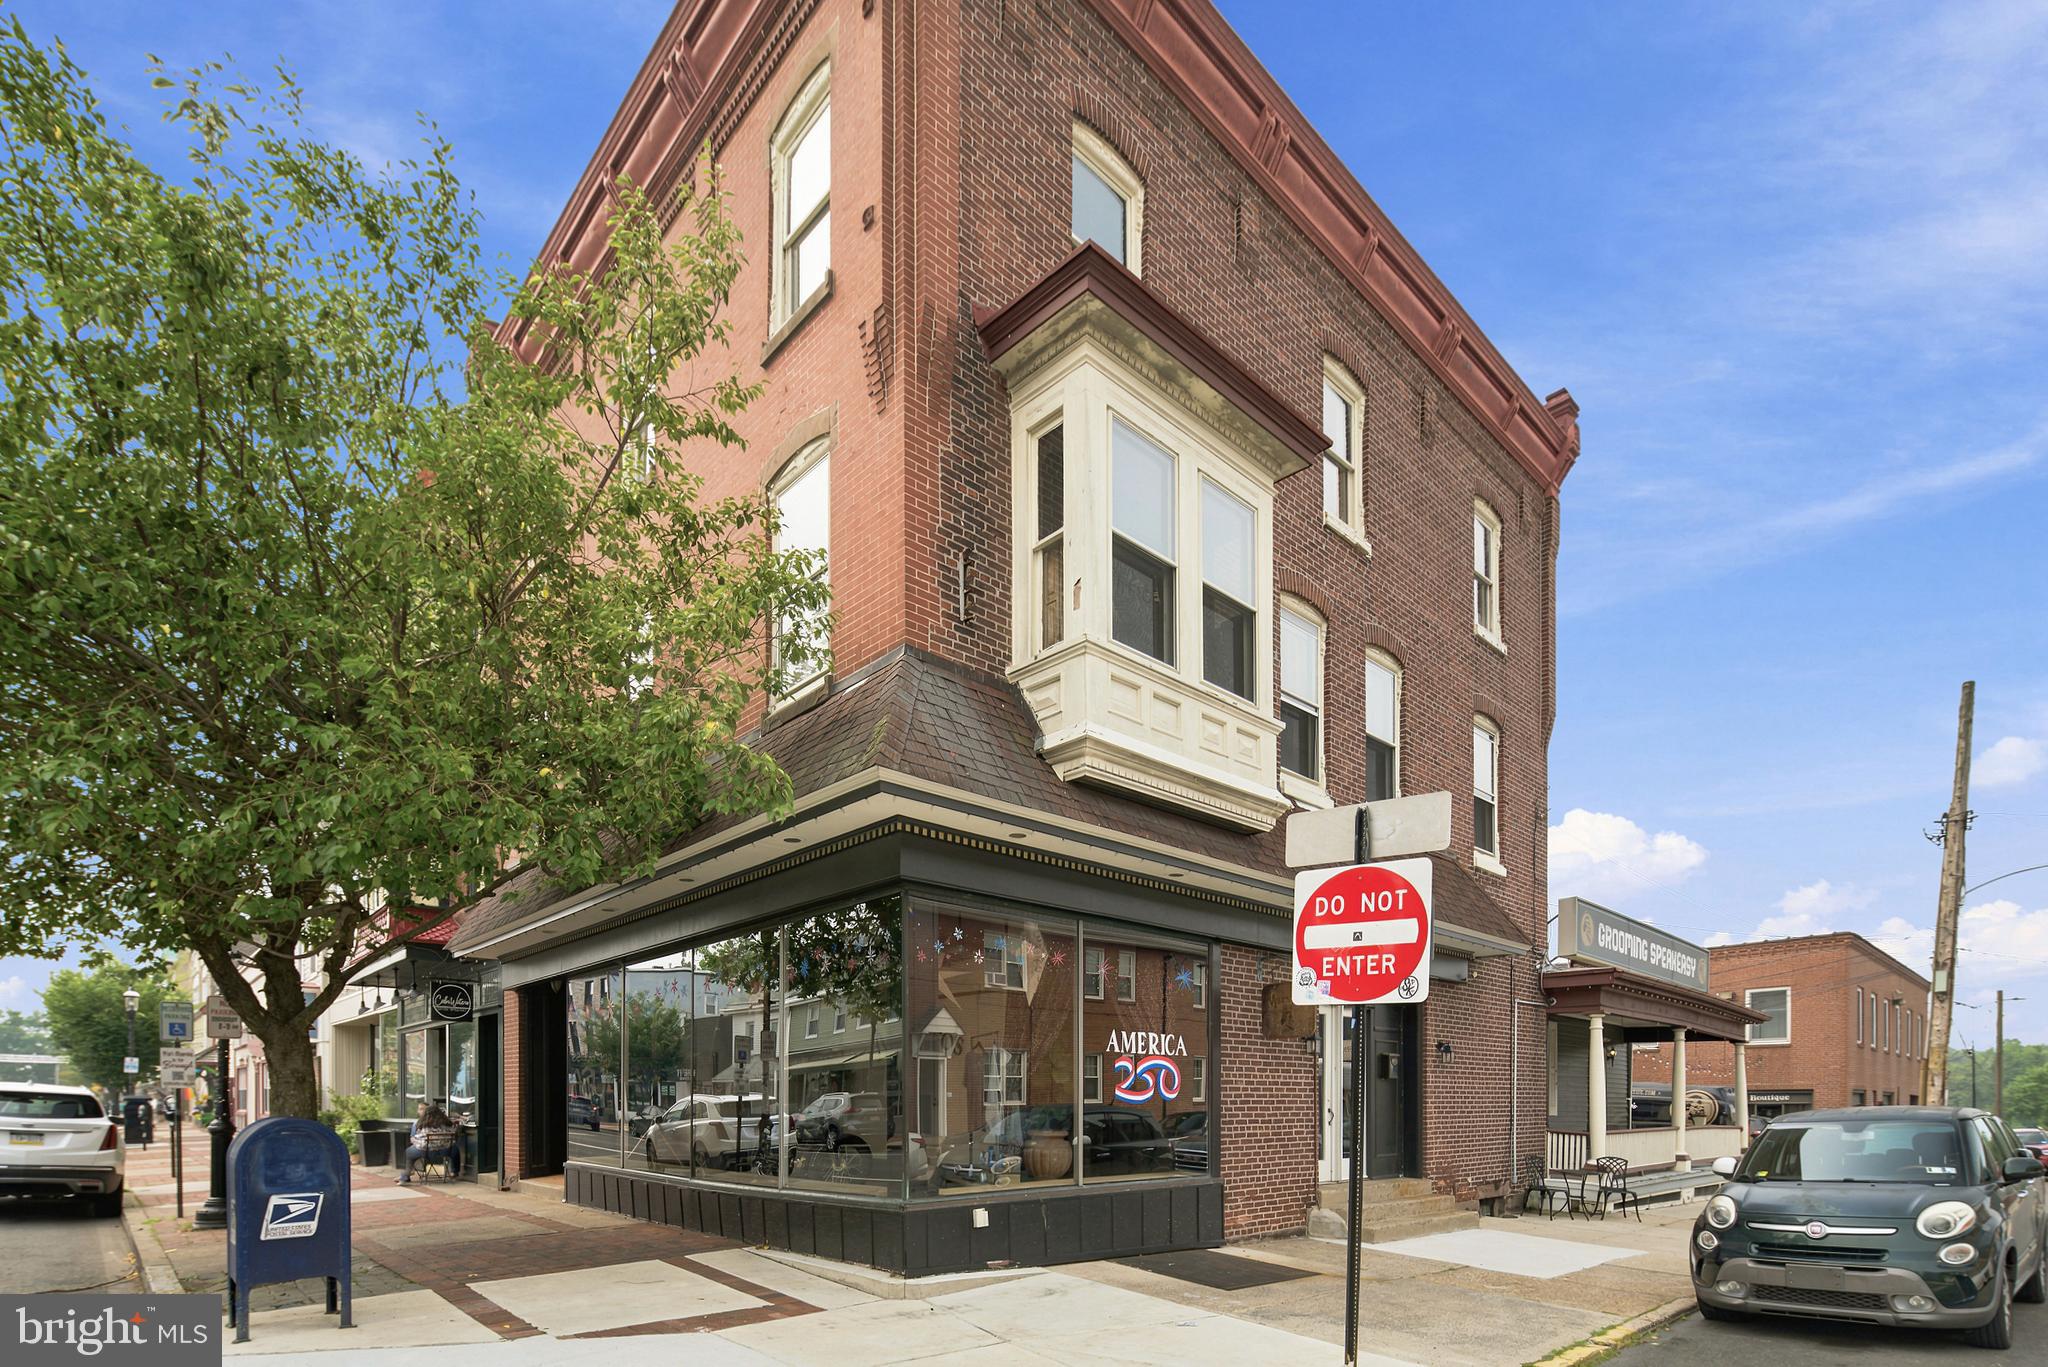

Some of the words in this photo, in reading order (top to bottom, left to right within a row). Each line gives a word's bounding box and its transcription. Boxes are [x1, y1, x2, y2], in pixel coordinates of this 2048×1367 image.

[1315, 895, 1345, 917] DO
[1361, 889, 1408, 913] NOT
[1597, 922, 1649, 962] GROOMING
[1649, 942, 1697, 979] SPEAKEASY
[1322, 953, 1396, 977] ENTER
[1106, 1028, 1188, 1056] AMERICA
[1113, 1055, 1181, 1104] 250
[1749, 1094, 1791, 1102] Boutique
